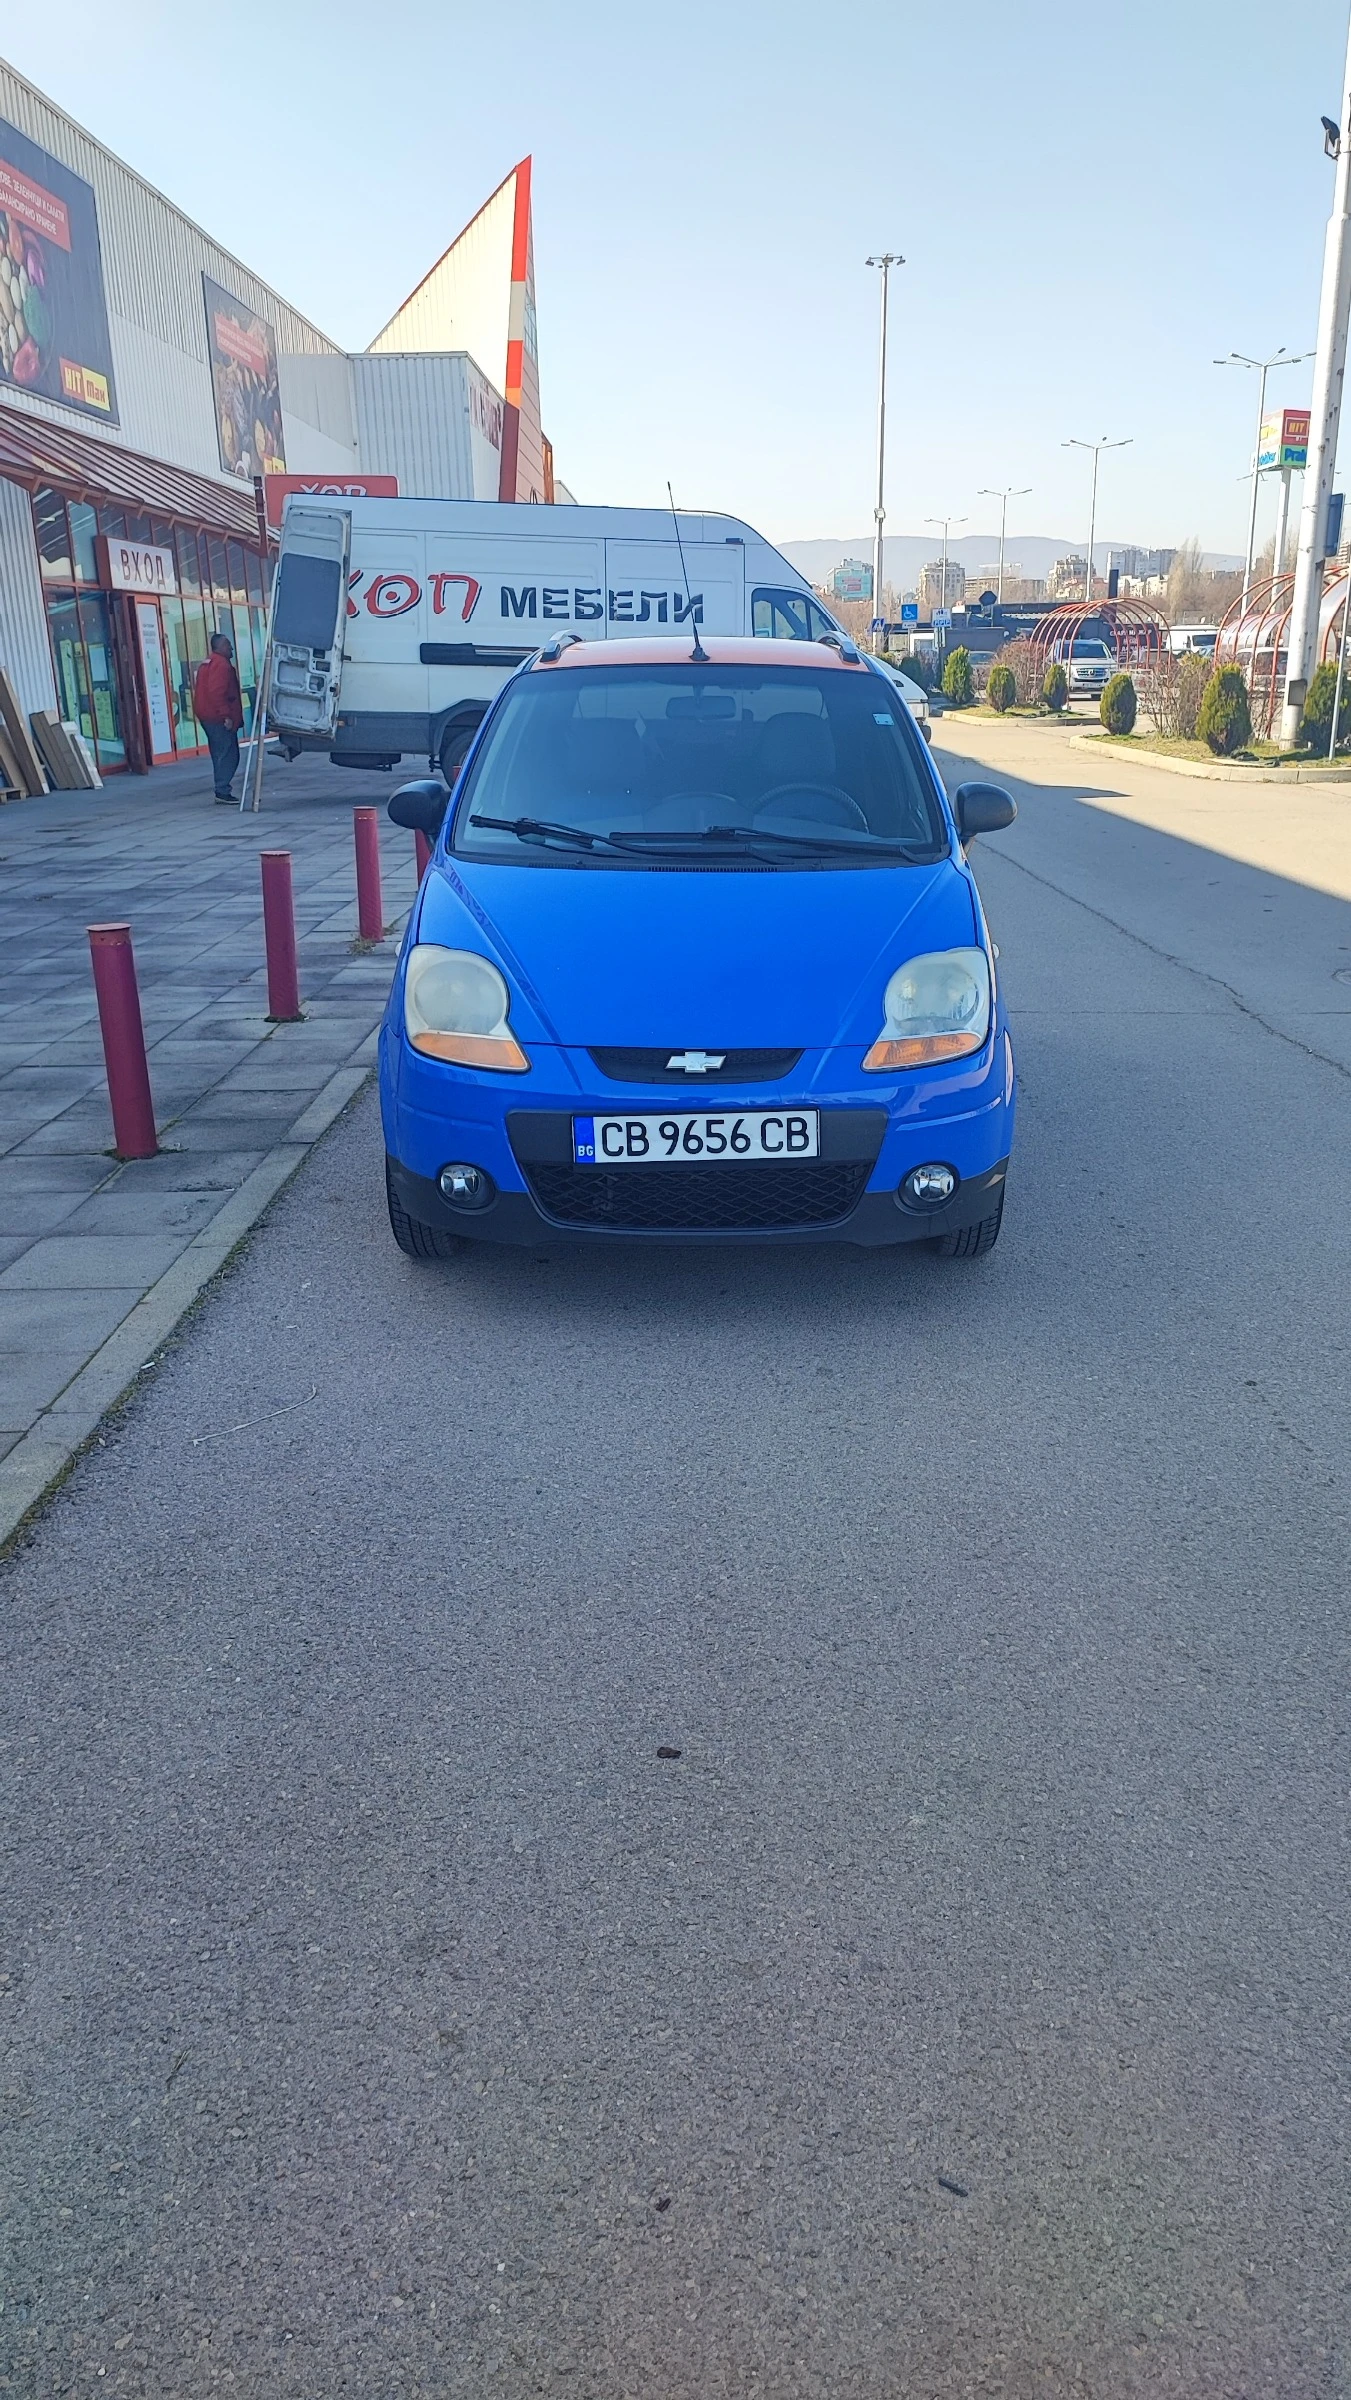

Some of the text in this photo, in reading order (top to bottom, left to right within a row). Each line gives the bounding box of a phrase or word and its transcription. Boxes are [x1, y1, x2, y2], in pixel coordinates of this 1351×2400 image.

[64, 367, 82, 394] HIT
[1288, 422, 1305, 433] HIT
[121, 549, 167, 591] ВХОД
[500, 586, 704, 624] МЕБЕЛИ
[577, 1117, 810, 1157] BG CB 9656 CB
